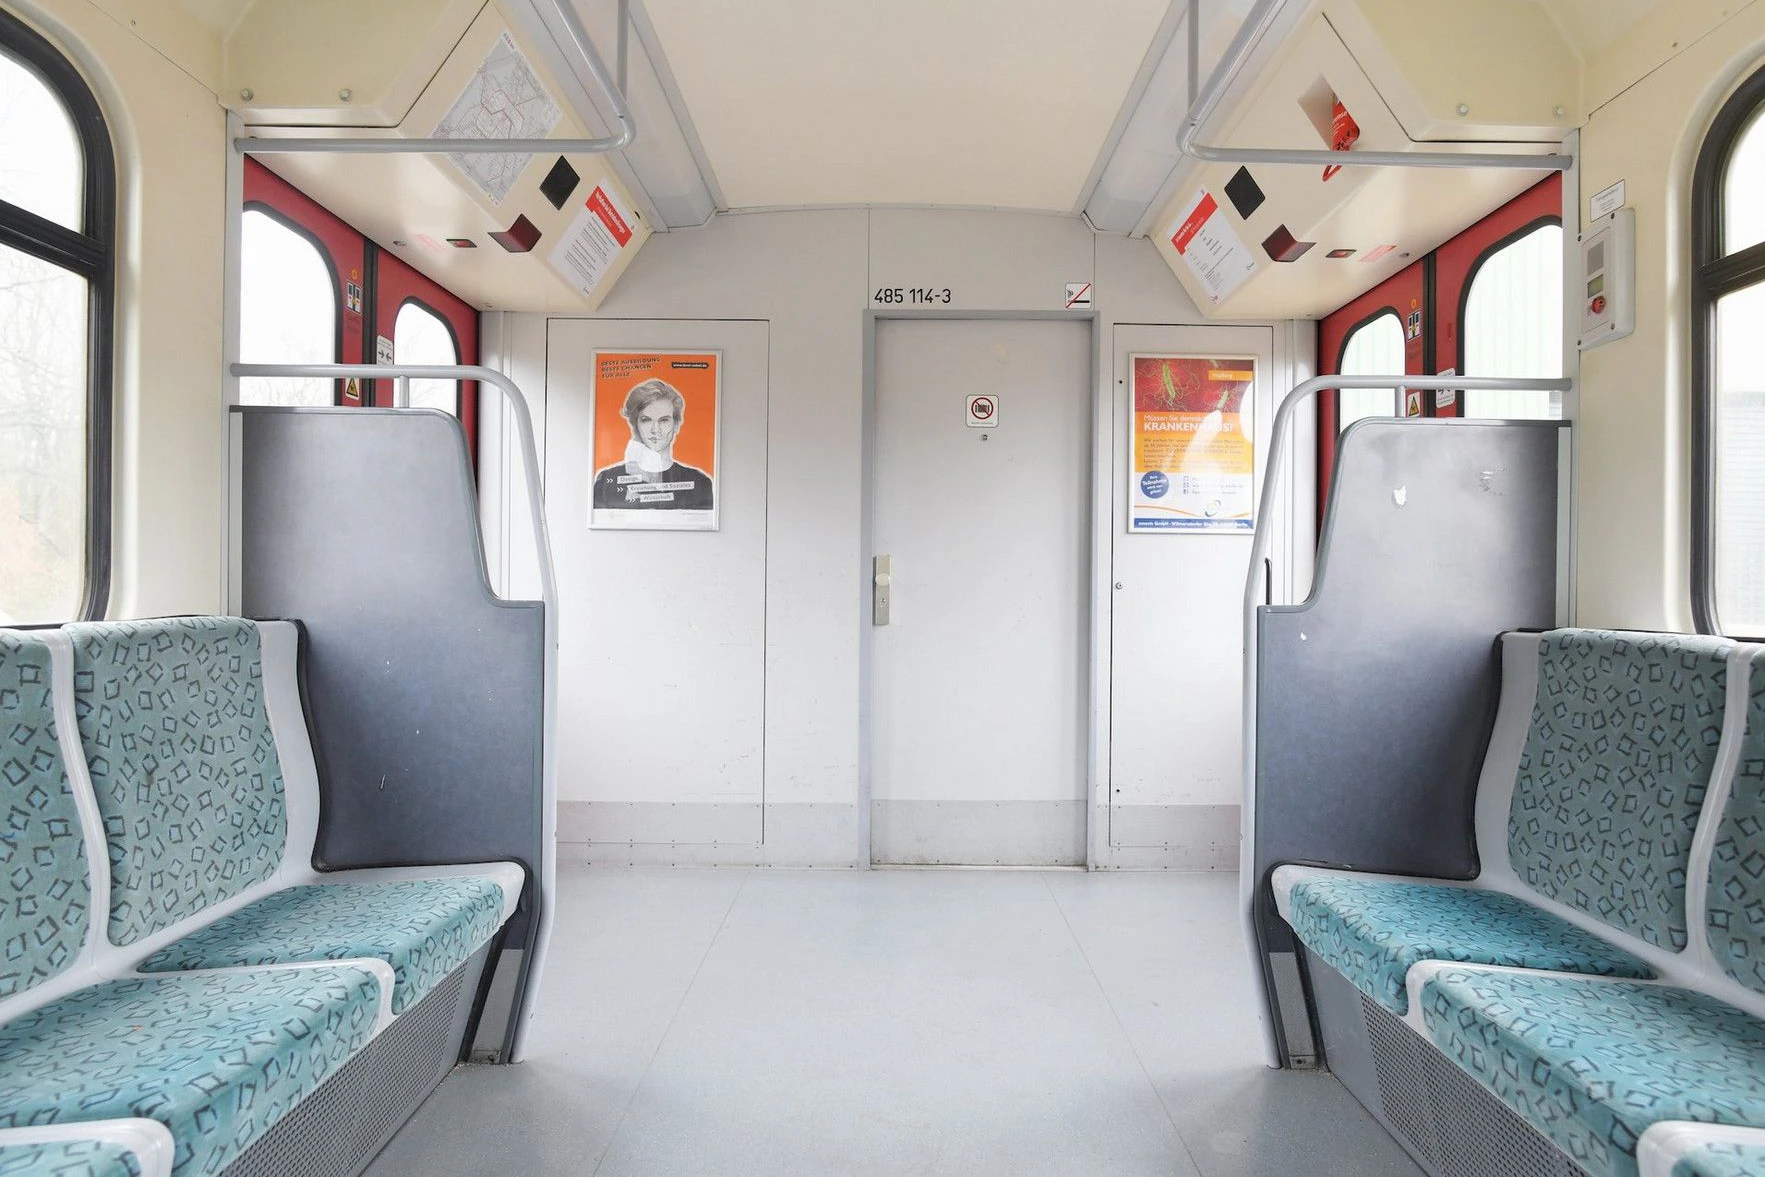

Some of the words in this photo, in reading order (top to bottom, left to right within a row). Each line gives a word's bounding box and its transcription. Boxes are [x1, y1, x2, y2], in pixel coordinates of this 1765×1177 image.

[874, 288, 904, 303] 485
[909, 288, 951, 303] 114-3
[621, 357, 661, 365] AUSBILDUNG
